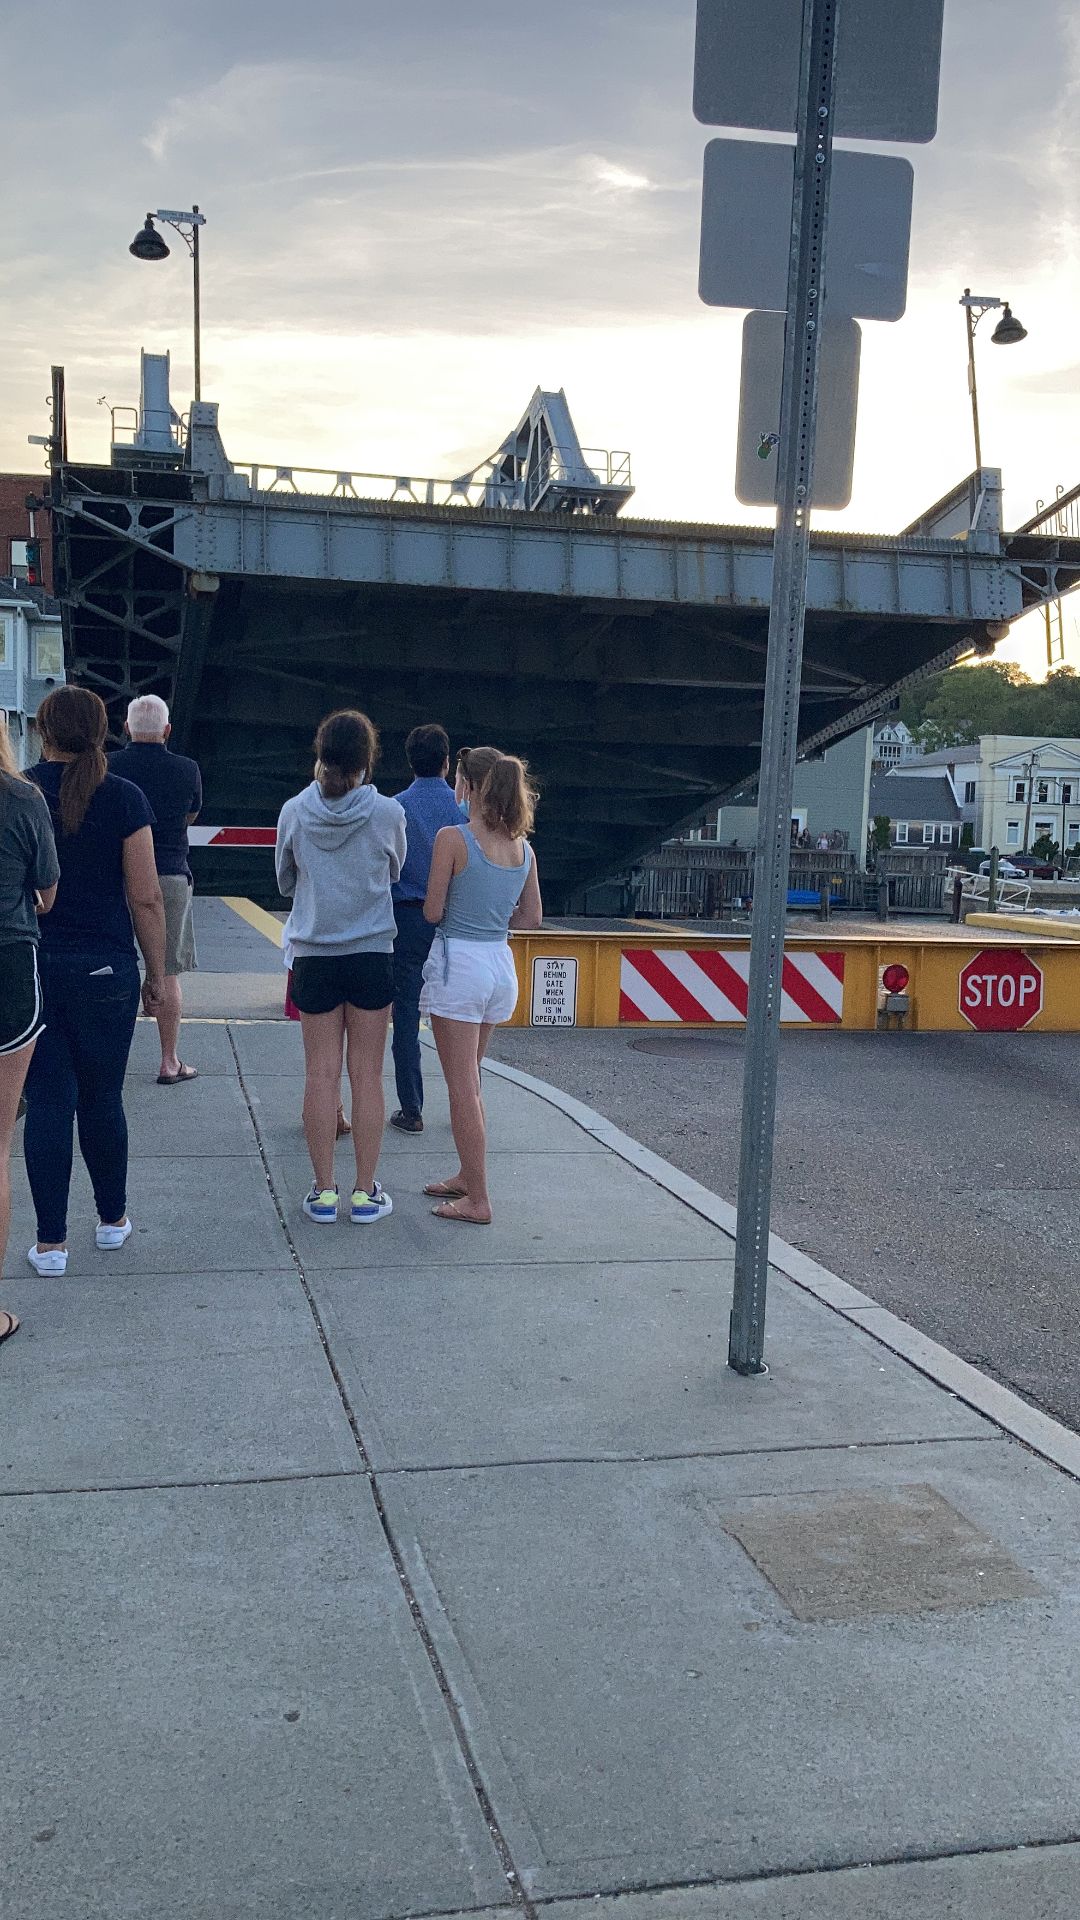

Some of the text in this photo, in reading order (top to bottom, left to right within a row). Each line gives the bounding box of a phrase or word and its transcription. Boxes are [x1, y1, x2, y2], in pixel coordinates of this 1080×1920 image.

[546, 962, 565, 970] STAY
[543, 971, 567, 979] BEHIND
[545, 980, 564, 988] GATE
[965, 974, 1037, 1007] STOP
[542, 997, 566, 1005] BRIDGE
[545, 1006, 562, 1014] IS IN
[534, 1015, 572, 1023] OPERATION
